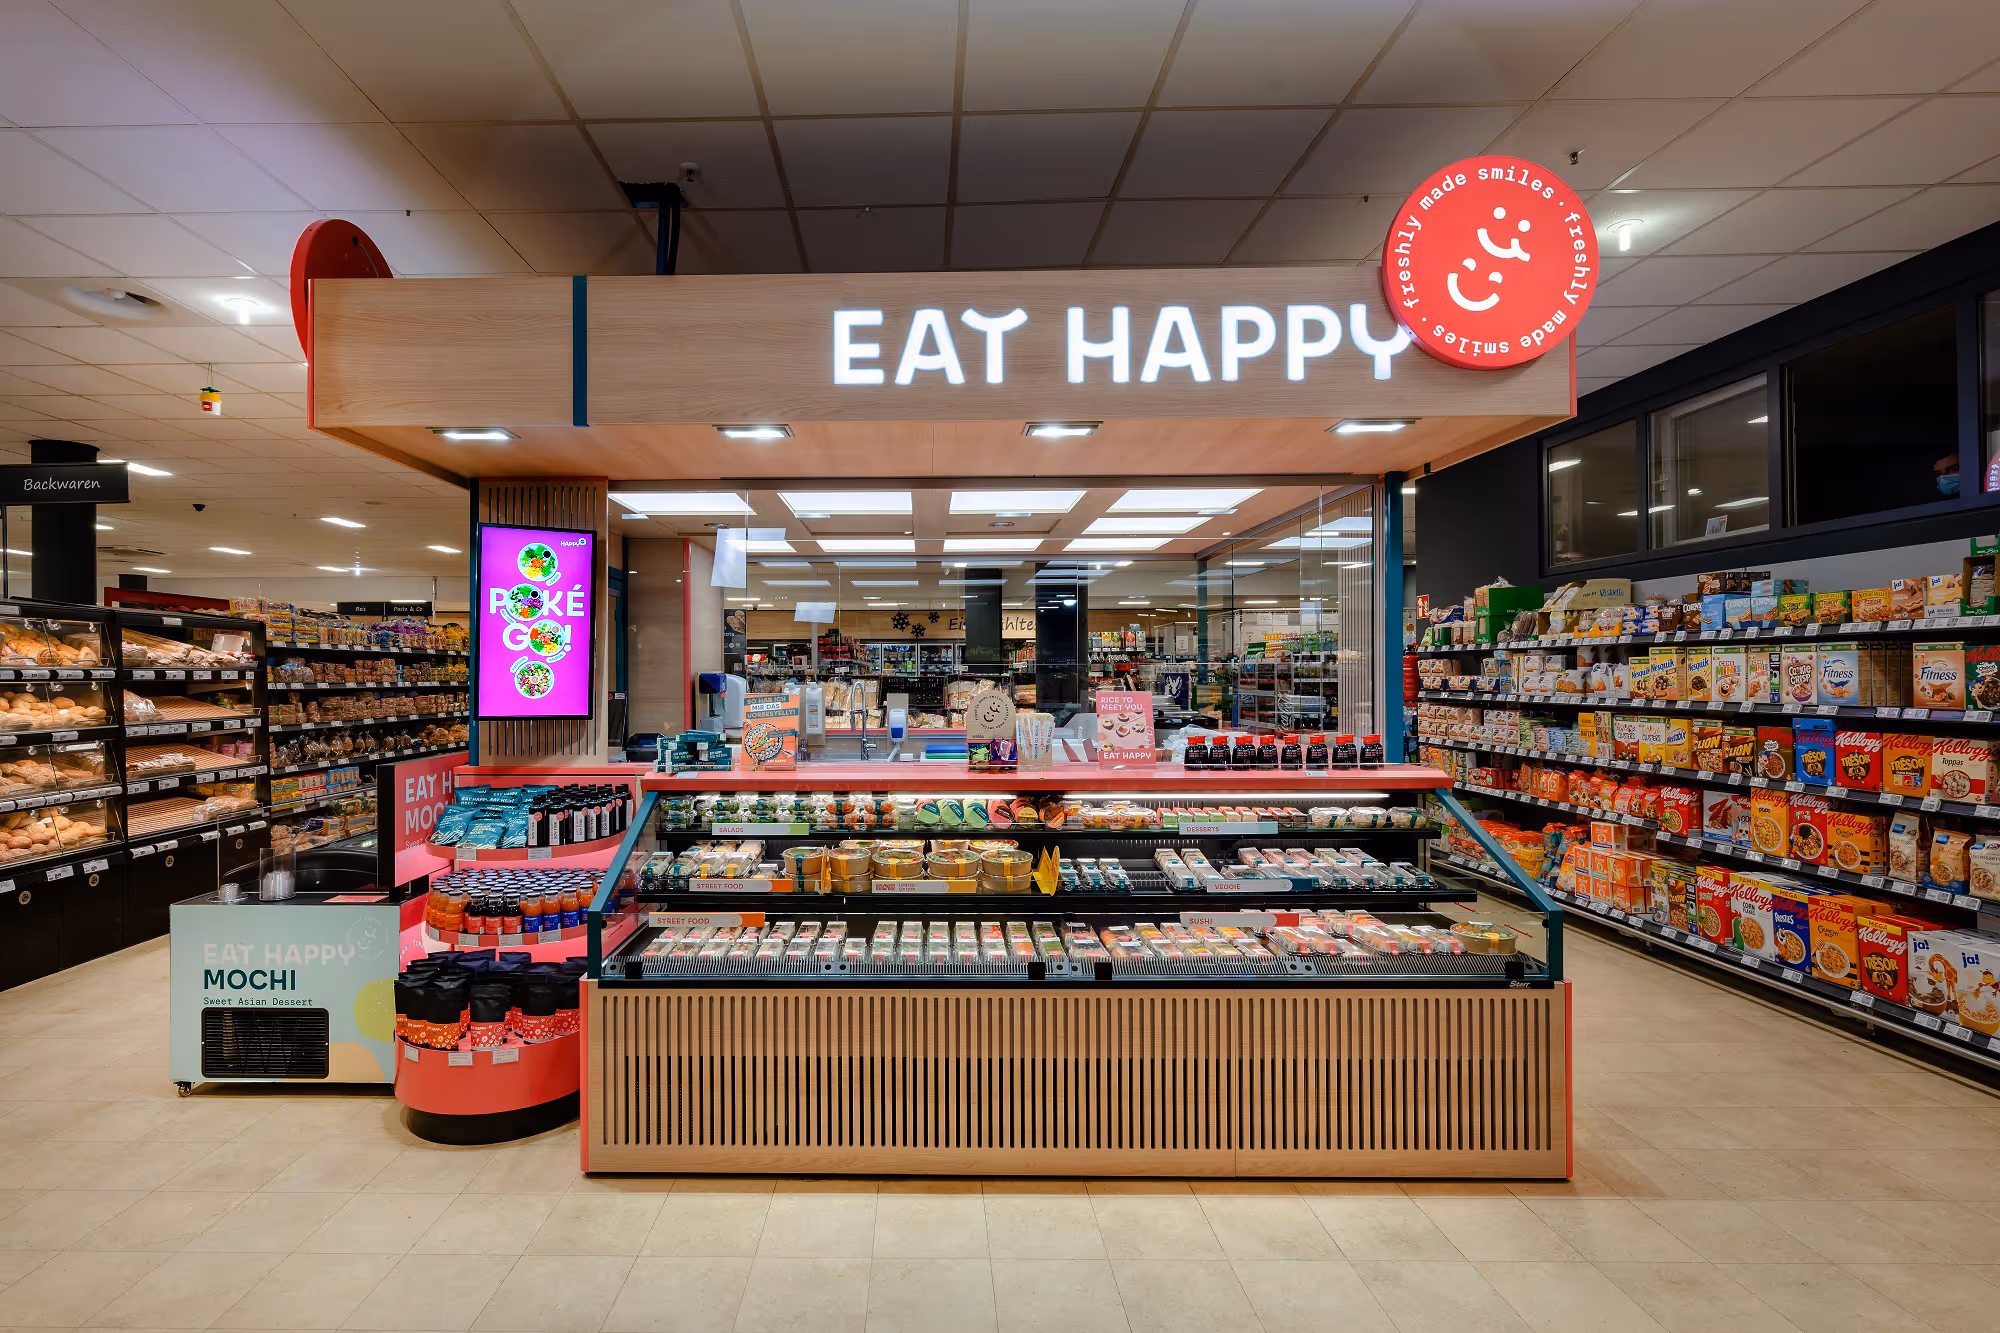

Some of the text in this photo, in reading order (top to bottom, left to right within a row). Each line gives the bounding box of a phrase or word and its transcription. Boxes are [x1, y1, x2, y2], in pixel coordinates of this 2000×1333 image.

[1395, 166, 1555, 308] freshly made smiles
[1433, 211, 1590, 356] freshly made smiles
[833, 303, 1411, 385] EAT HAPPY
[24, 477, 101, 491] Backwaren
[1893, 581, 1902, 589] ja!
[1931, 577, 1940, 586] ja!
[1651, 658, 1674, 672] Nesquik
[1688, 658, 1709, 672] Nesquik
[1823, 666, 1853, 678] Fitness
[1920, 666, 1957, 680] Fitness
[747, 710, 796, 718] VORBESTELLT!
[1642, 734, 1661, 742] CLUSTERS
[1698, 734, 1721, 749] LION
[1730, 742, 1754, 757] LION
[1942, 758, 1963, 767] Toppas
[405, 773, 438, 804] EAT
[1702, 869, 1716, 878] MEGA
[1740, 876, 1760, 886] FAMILY
[1780, 890, 1798, 899] MEGA
[1742, 902, 1755, 910] CORN
[1820, 900, 1842, 910] MEGA
[1868, 921, 1888, 931] MEGA
[1913, 938, 1930, 953] ja!
[203, 944, 355, 966] EAT HAPPY
[1961, 952, 1980, 968] ja!
[203, 969, 296, 991] MOCHI
[203, 997, 313, 1006] Sweet Asian Dessert
